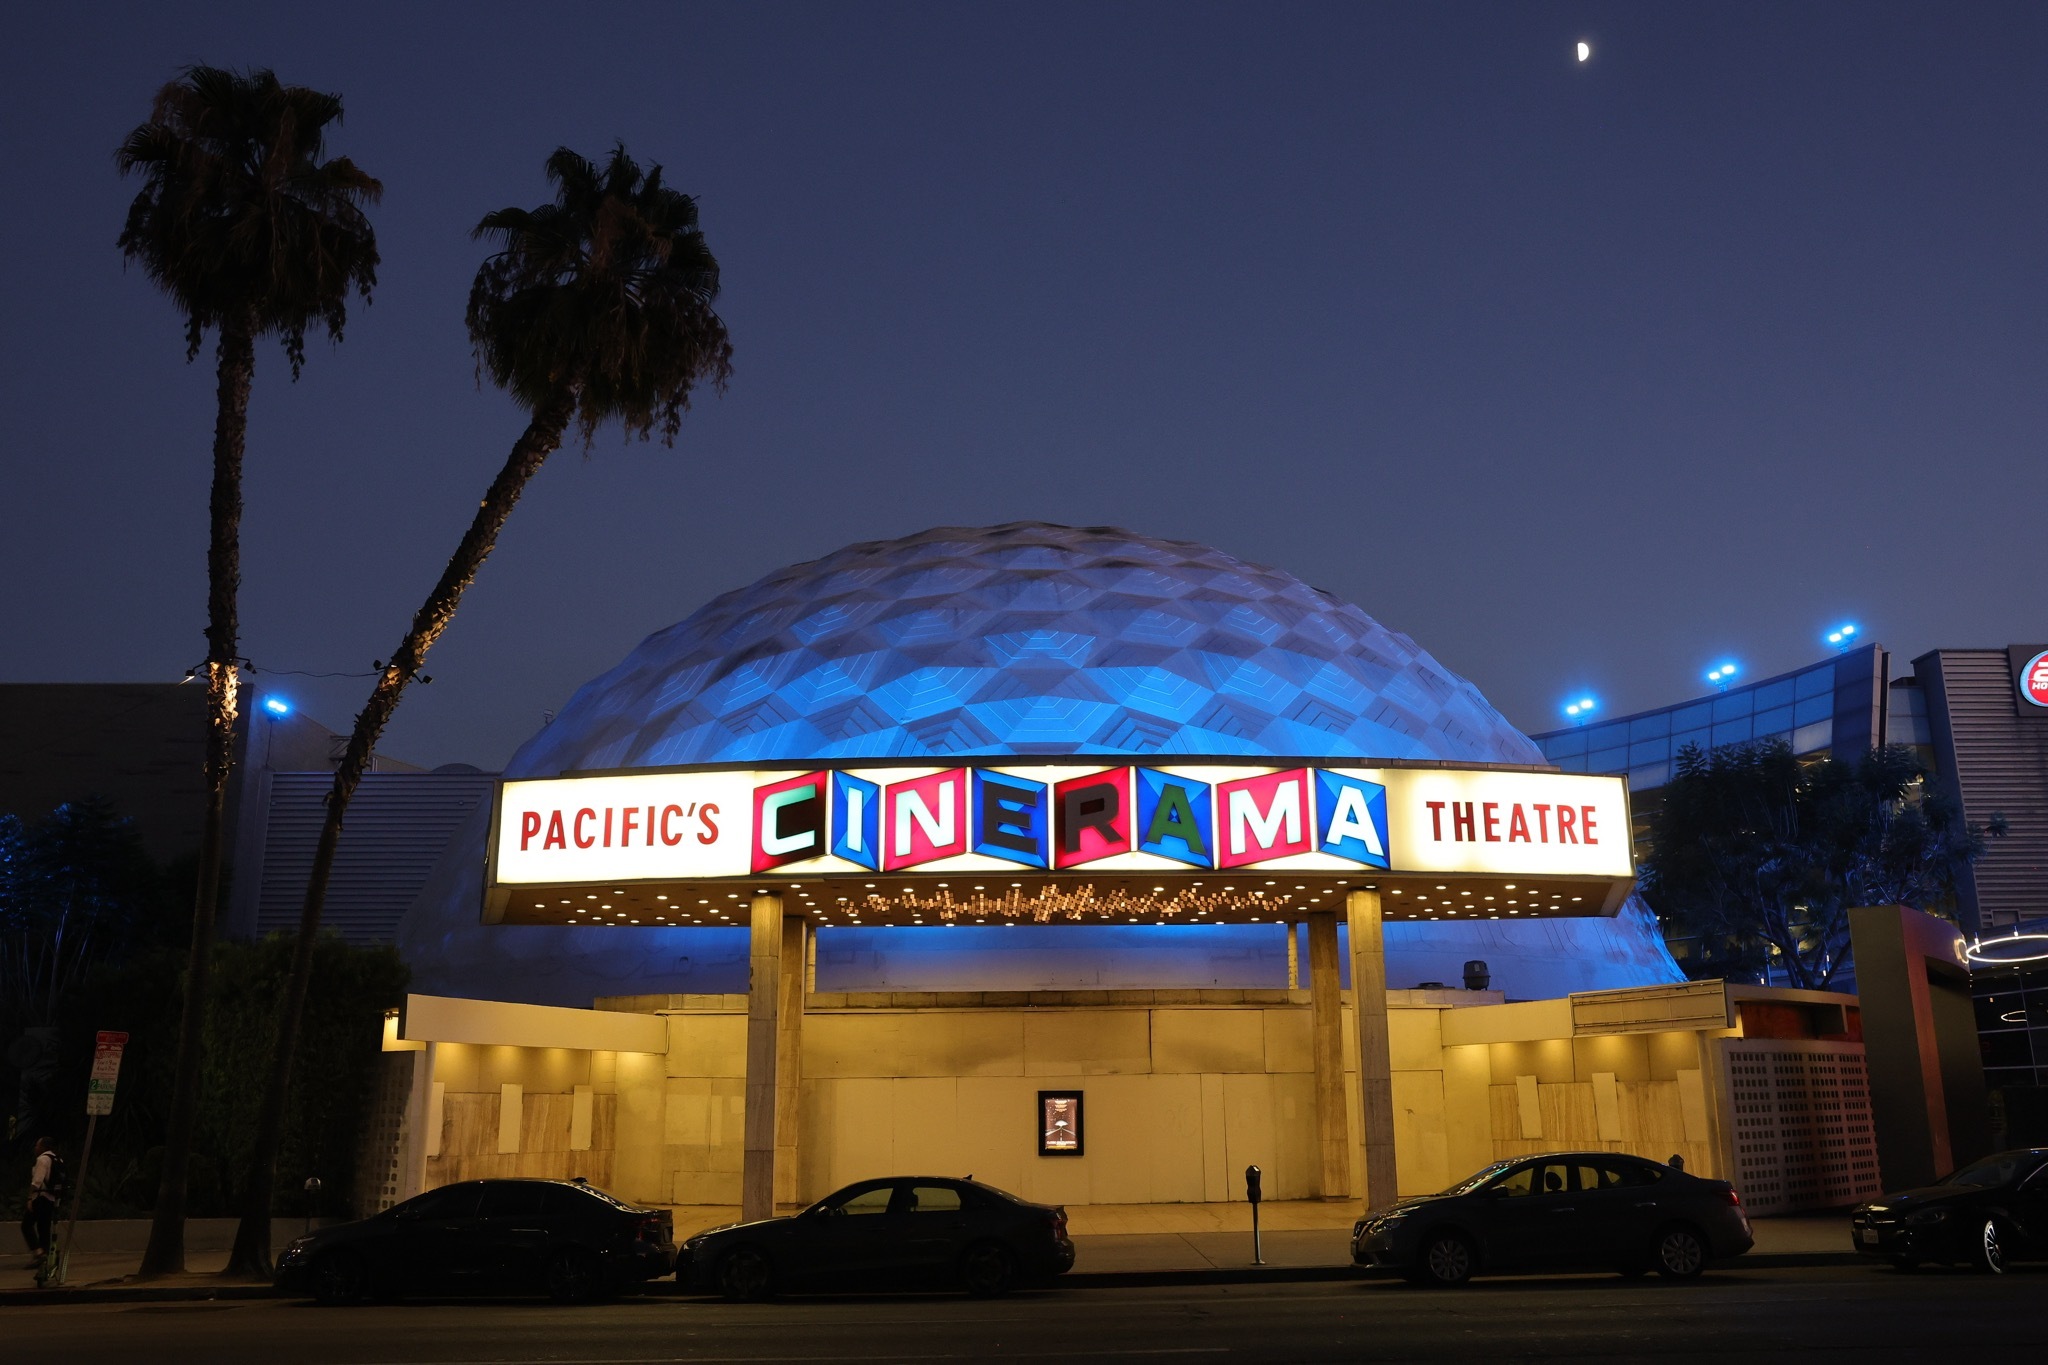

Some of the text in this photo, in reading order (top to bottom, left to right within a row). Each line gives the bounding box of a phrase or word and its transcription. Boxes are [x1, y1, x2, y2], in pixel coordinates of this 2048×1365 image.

[520, 780, 1599, 857] PACIFIC'S CINERAMA THEATRE
